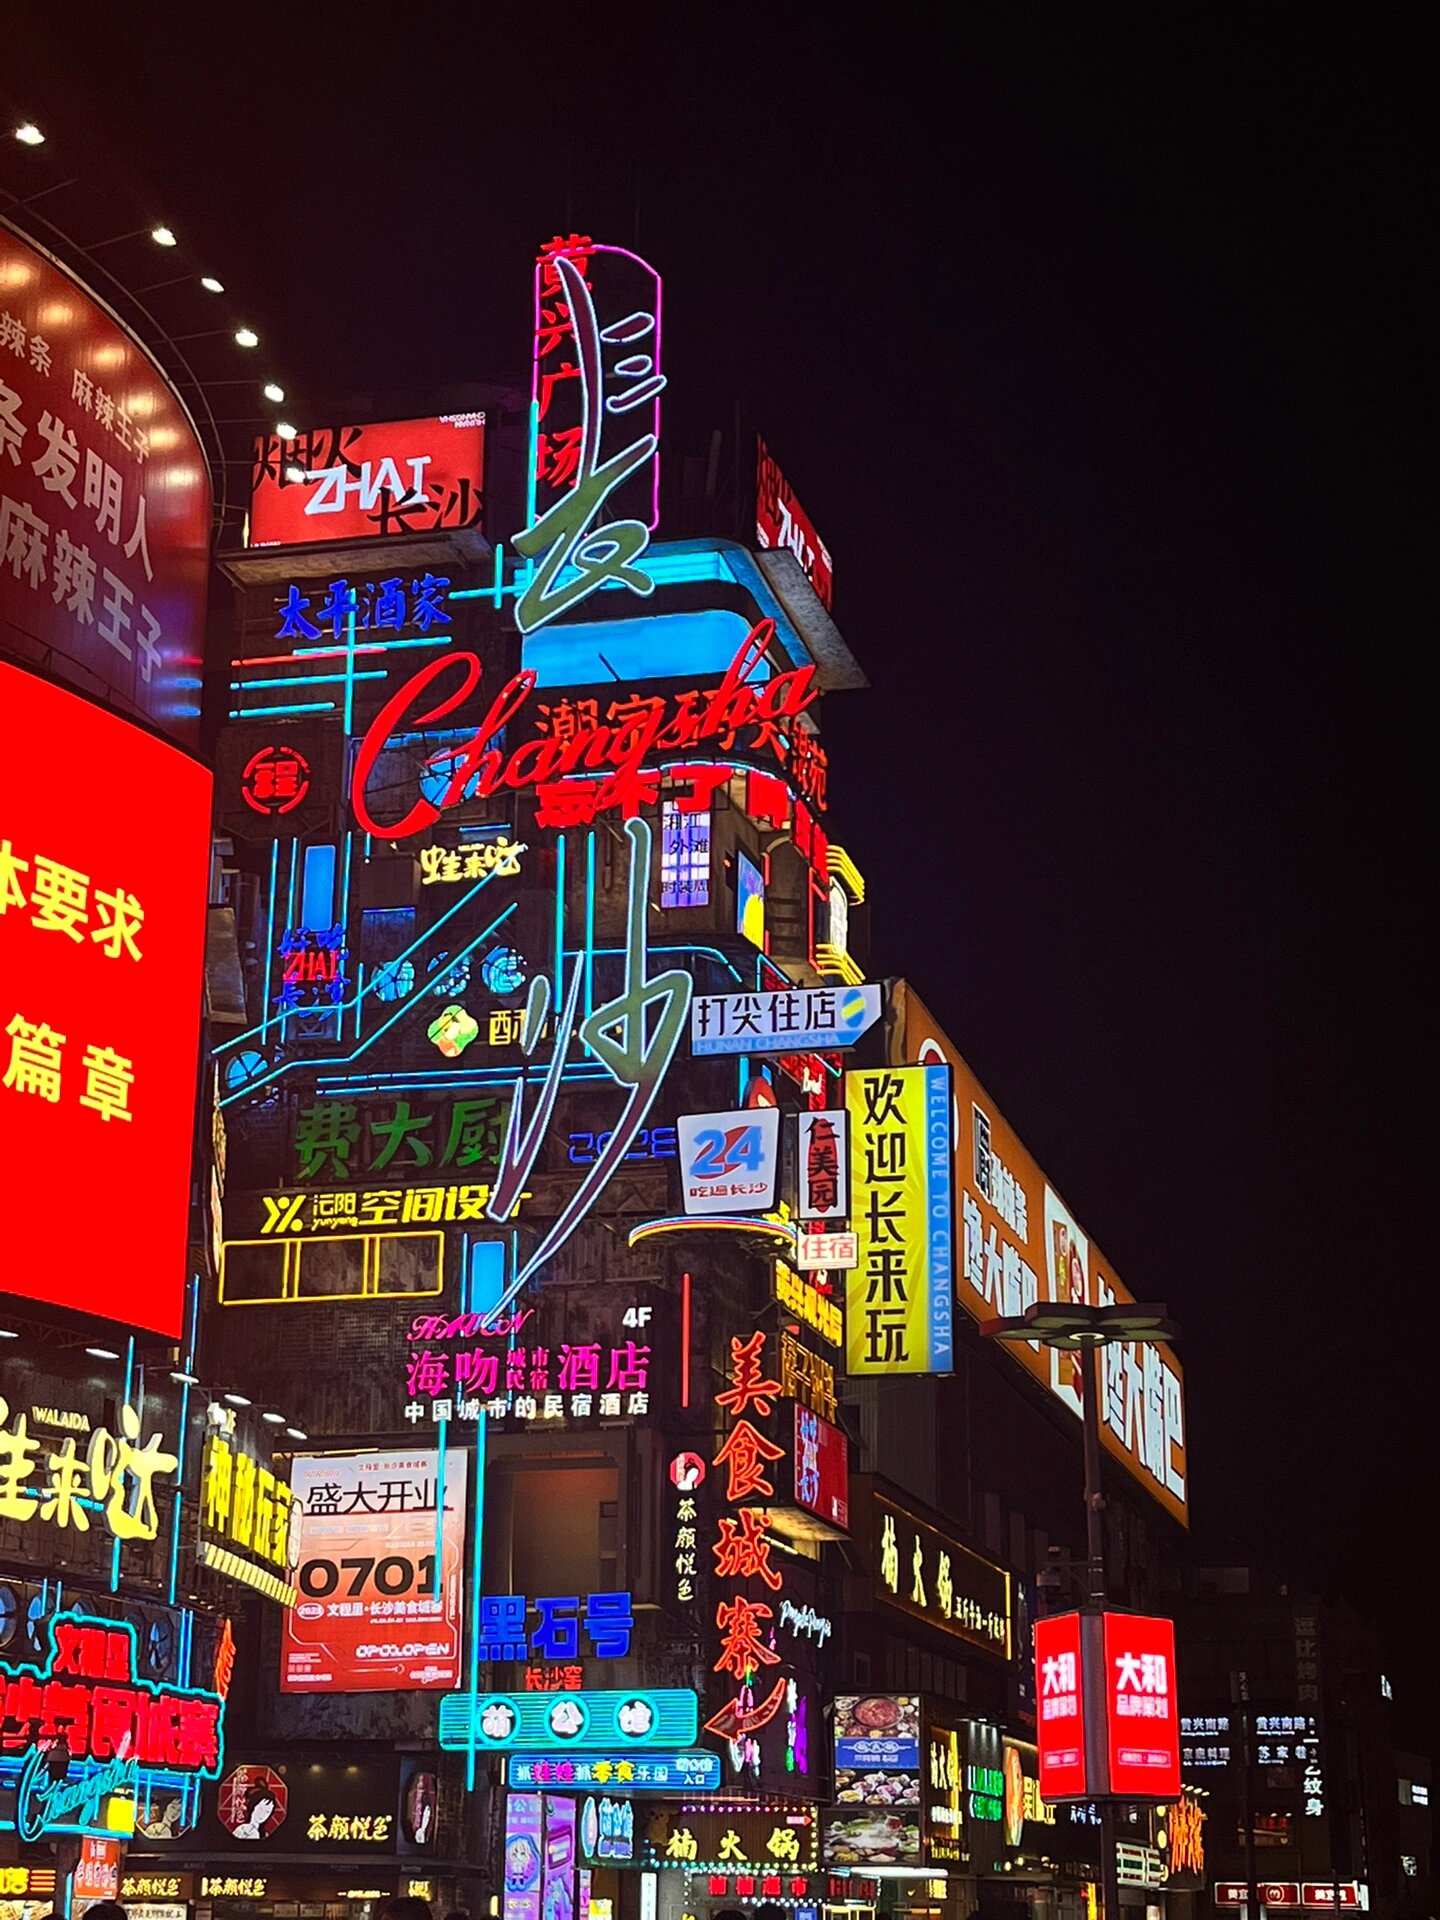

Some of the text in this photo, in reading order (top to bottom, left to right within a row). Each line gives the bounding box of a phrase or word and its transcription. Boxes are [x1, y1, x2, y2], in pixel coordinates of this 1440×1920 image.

[71, 369, 150, 464] 麻辣王子
[304, 456, 432, 515] ZHAI
[367, 479, 484, 537] 长沙
[275, 573, 452, 640] 太平酒家
[350, 618, 819, 842] Changsha
[669, 838, 709, 855] 外滩
[698, 991, 835, 1037] 打尖住店
[697, 1033, 841, 1053] HUNAN CHANGSHA
[2, 1013, 134, 1122] 篇 章
[690, 1125, 765, 1176] 24
[805, 1116, 840, 1211] 仁美园
[690, 1182, 768, 1197] 吃遍长沙
[863, 1073, 908, 1363] 欢迎长来玩
[926, 1076, 950, 1355] WELCOME TO CHANGSHA
[802, 1236, 855, 1262] 住宿
[622, 1307, 652, 1328] 4F
[406, 1341, 651, 1397] 海吻 酒店
[32, 1406, 90, 1433] WALAIDA
[404, 1391, 649, 1423] 中国城市的民宿酒店
[306, 1478, 449, 1516] 盛大开业
[711, 1330, 786, 1680] 美食城寨
[674, 1499, 698, 1602] 茶颜悦色
[299, 1556, 443, 1597] 0701
[477, 1591, 634, 1661] 黑石号
[1115, 1652, 1168, 1695] 大和
[307, 1814, 391, 1841] 茶颜悦色
[121, 1877, 181, 1897] 茶颜悦色
[208, 1877, 267, 1897] 茶颜悦色
